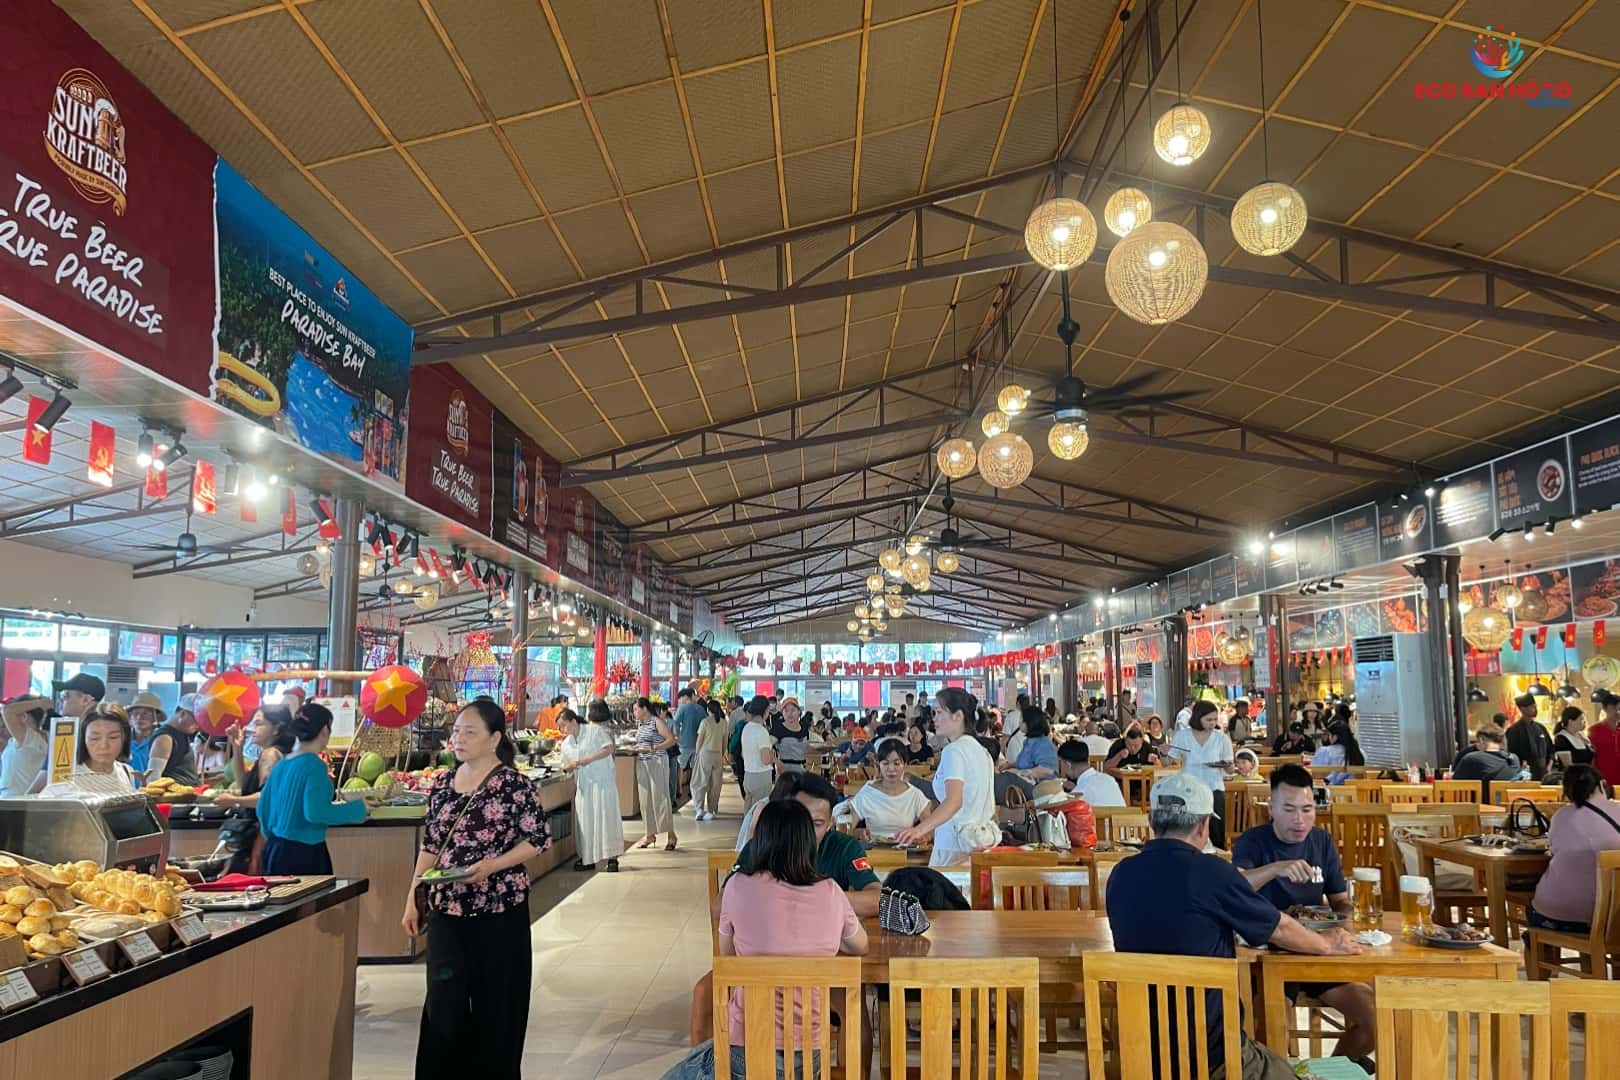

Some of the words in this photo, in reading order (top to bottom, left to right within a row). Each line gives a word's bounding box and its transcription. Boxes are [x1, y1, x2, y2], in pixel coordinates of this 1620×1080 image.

[54, 86, 94, 141] SUN
[46, 111, 127, 193] KRAFTBEER
[15, 172, 78, 240] TRUE
[84, 224, 144, 287] BEER
[54, 252, 163, 333] PARADISE
[268, 267, 286, 290] BEST
[287, 281, 307, 307] PLACE
[307, 297, 317, 313] TO
[316, 305, 336, 329] ENJOY
[280, 299, 341, 357] PARADISE
[342, 344, 366, 379] BAY
[432, 465, 449, 491] TRUE
[449, 481, 480, 513] PARADISE
[440, 448, 457, 475] TRUE
[458, 463, 474, 490] BEER
